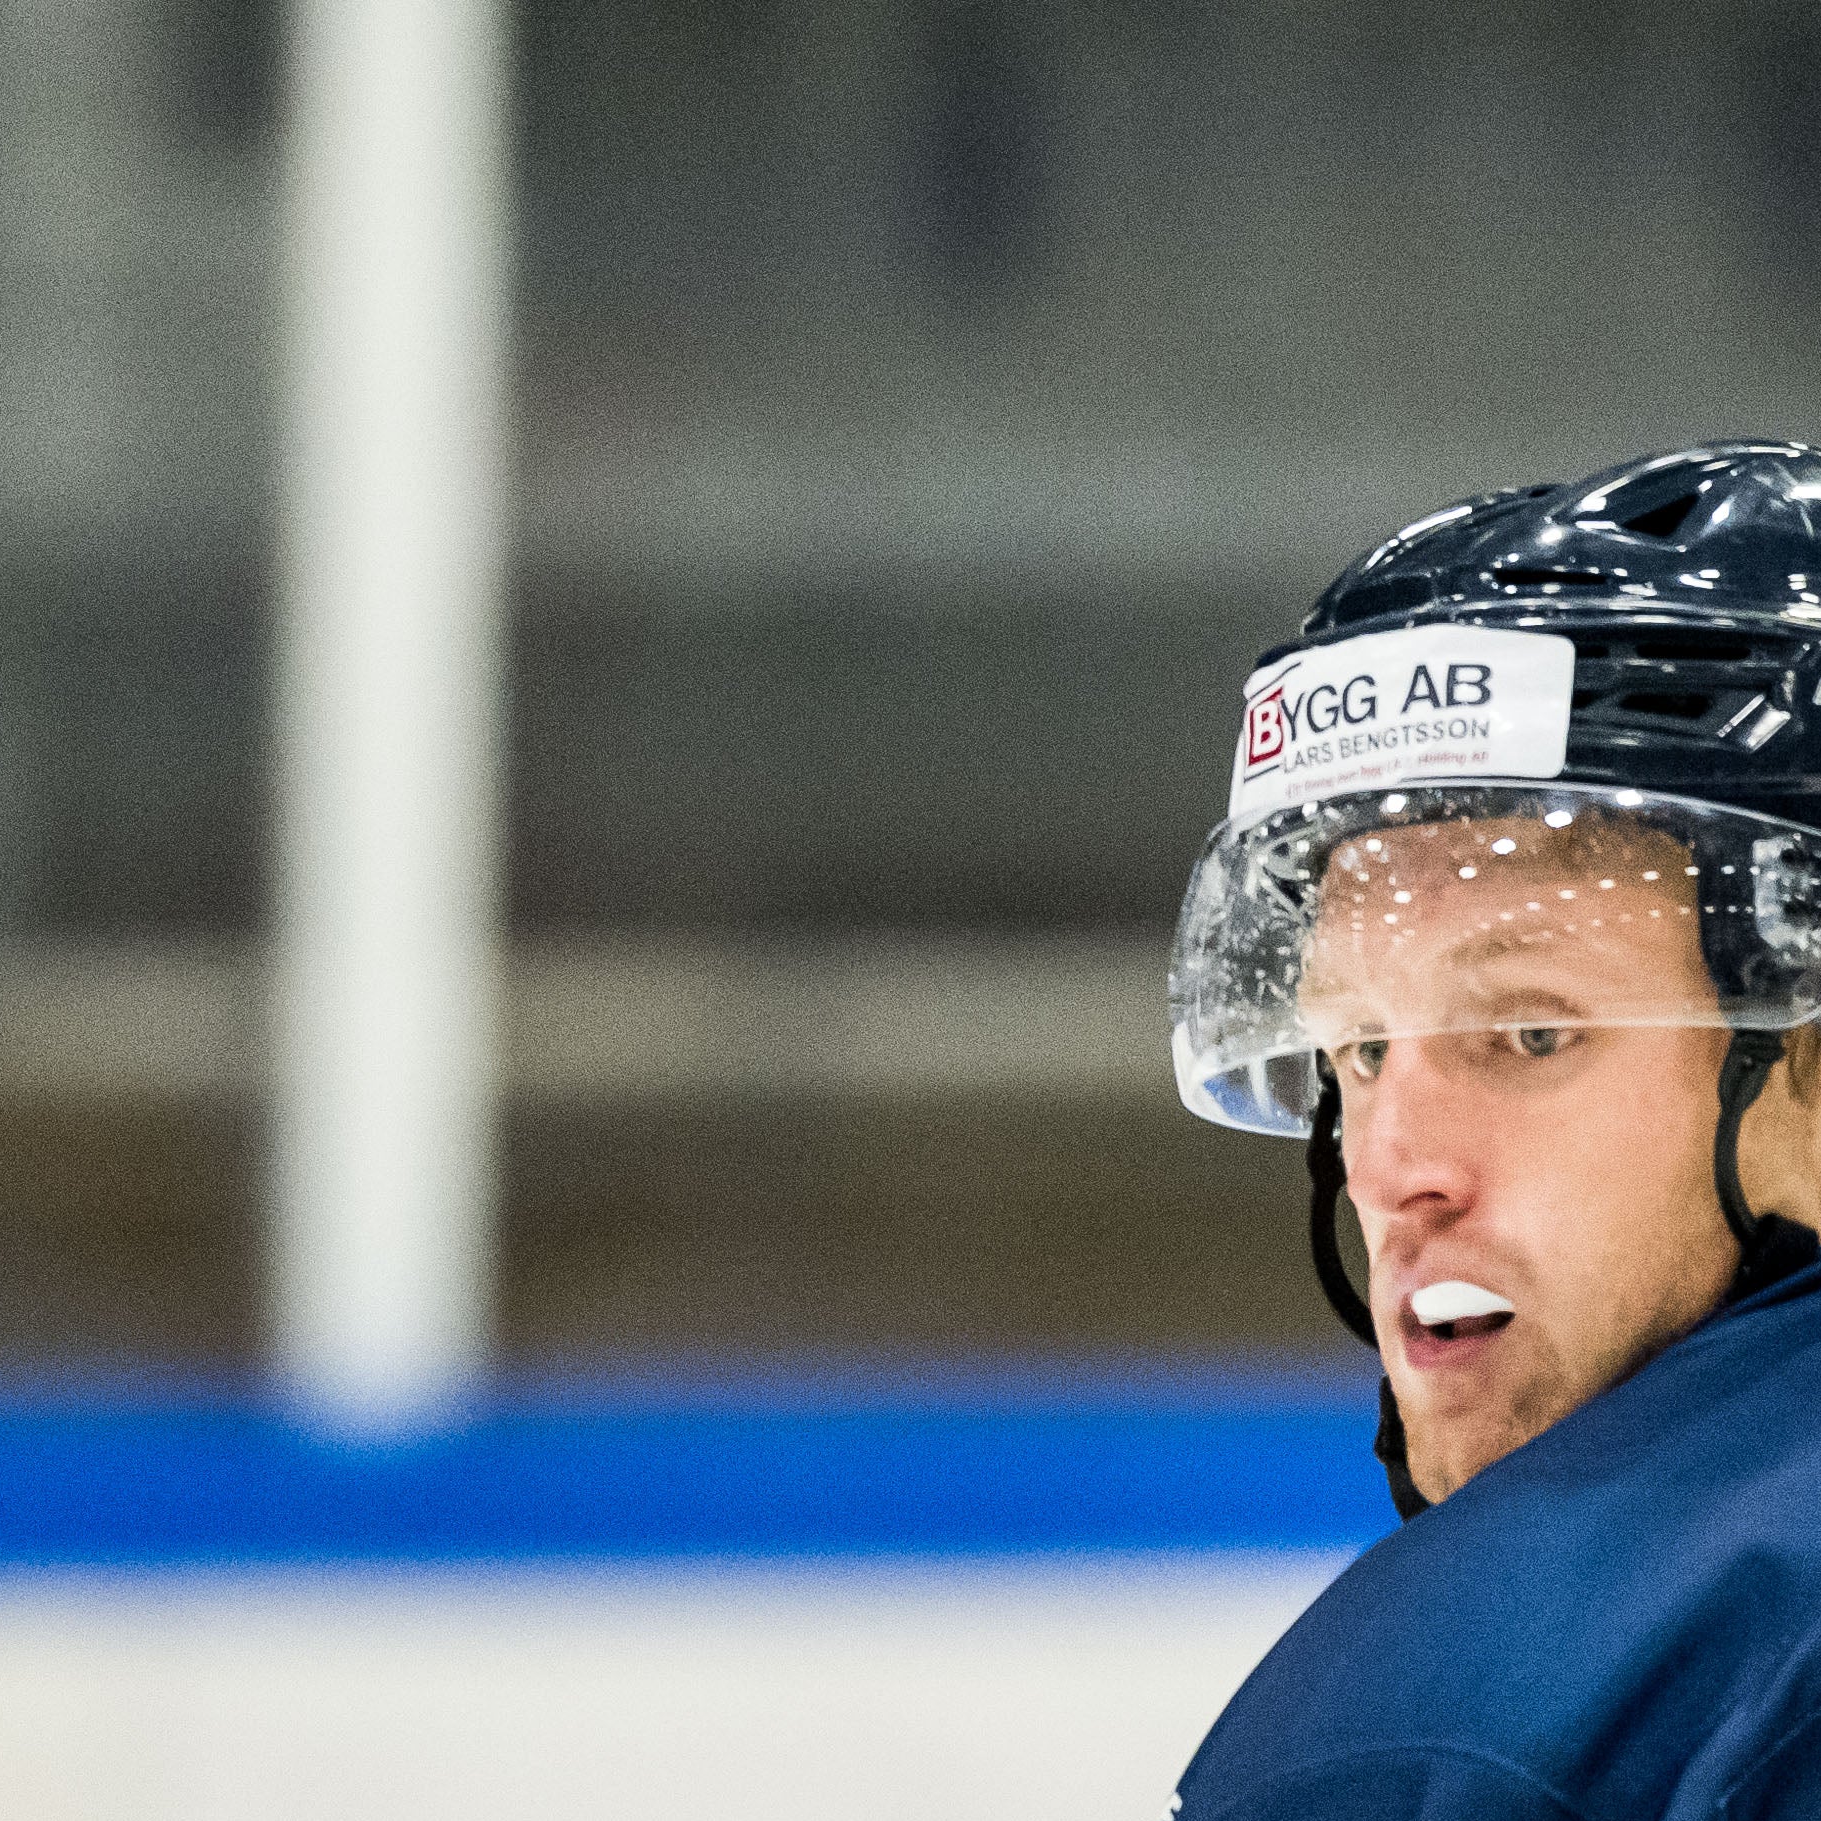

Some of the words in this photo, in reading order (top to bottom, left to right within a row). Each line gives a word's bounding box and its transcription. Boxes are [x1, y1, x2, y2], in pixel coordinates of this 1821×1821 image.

[1250, 674, 1378, 763] BYGG
[1401, 663, 1492, 713] AB
[1283, 743, 1334, 774] LARS
[1339, 716, 1491, 759] BENGTSSON
